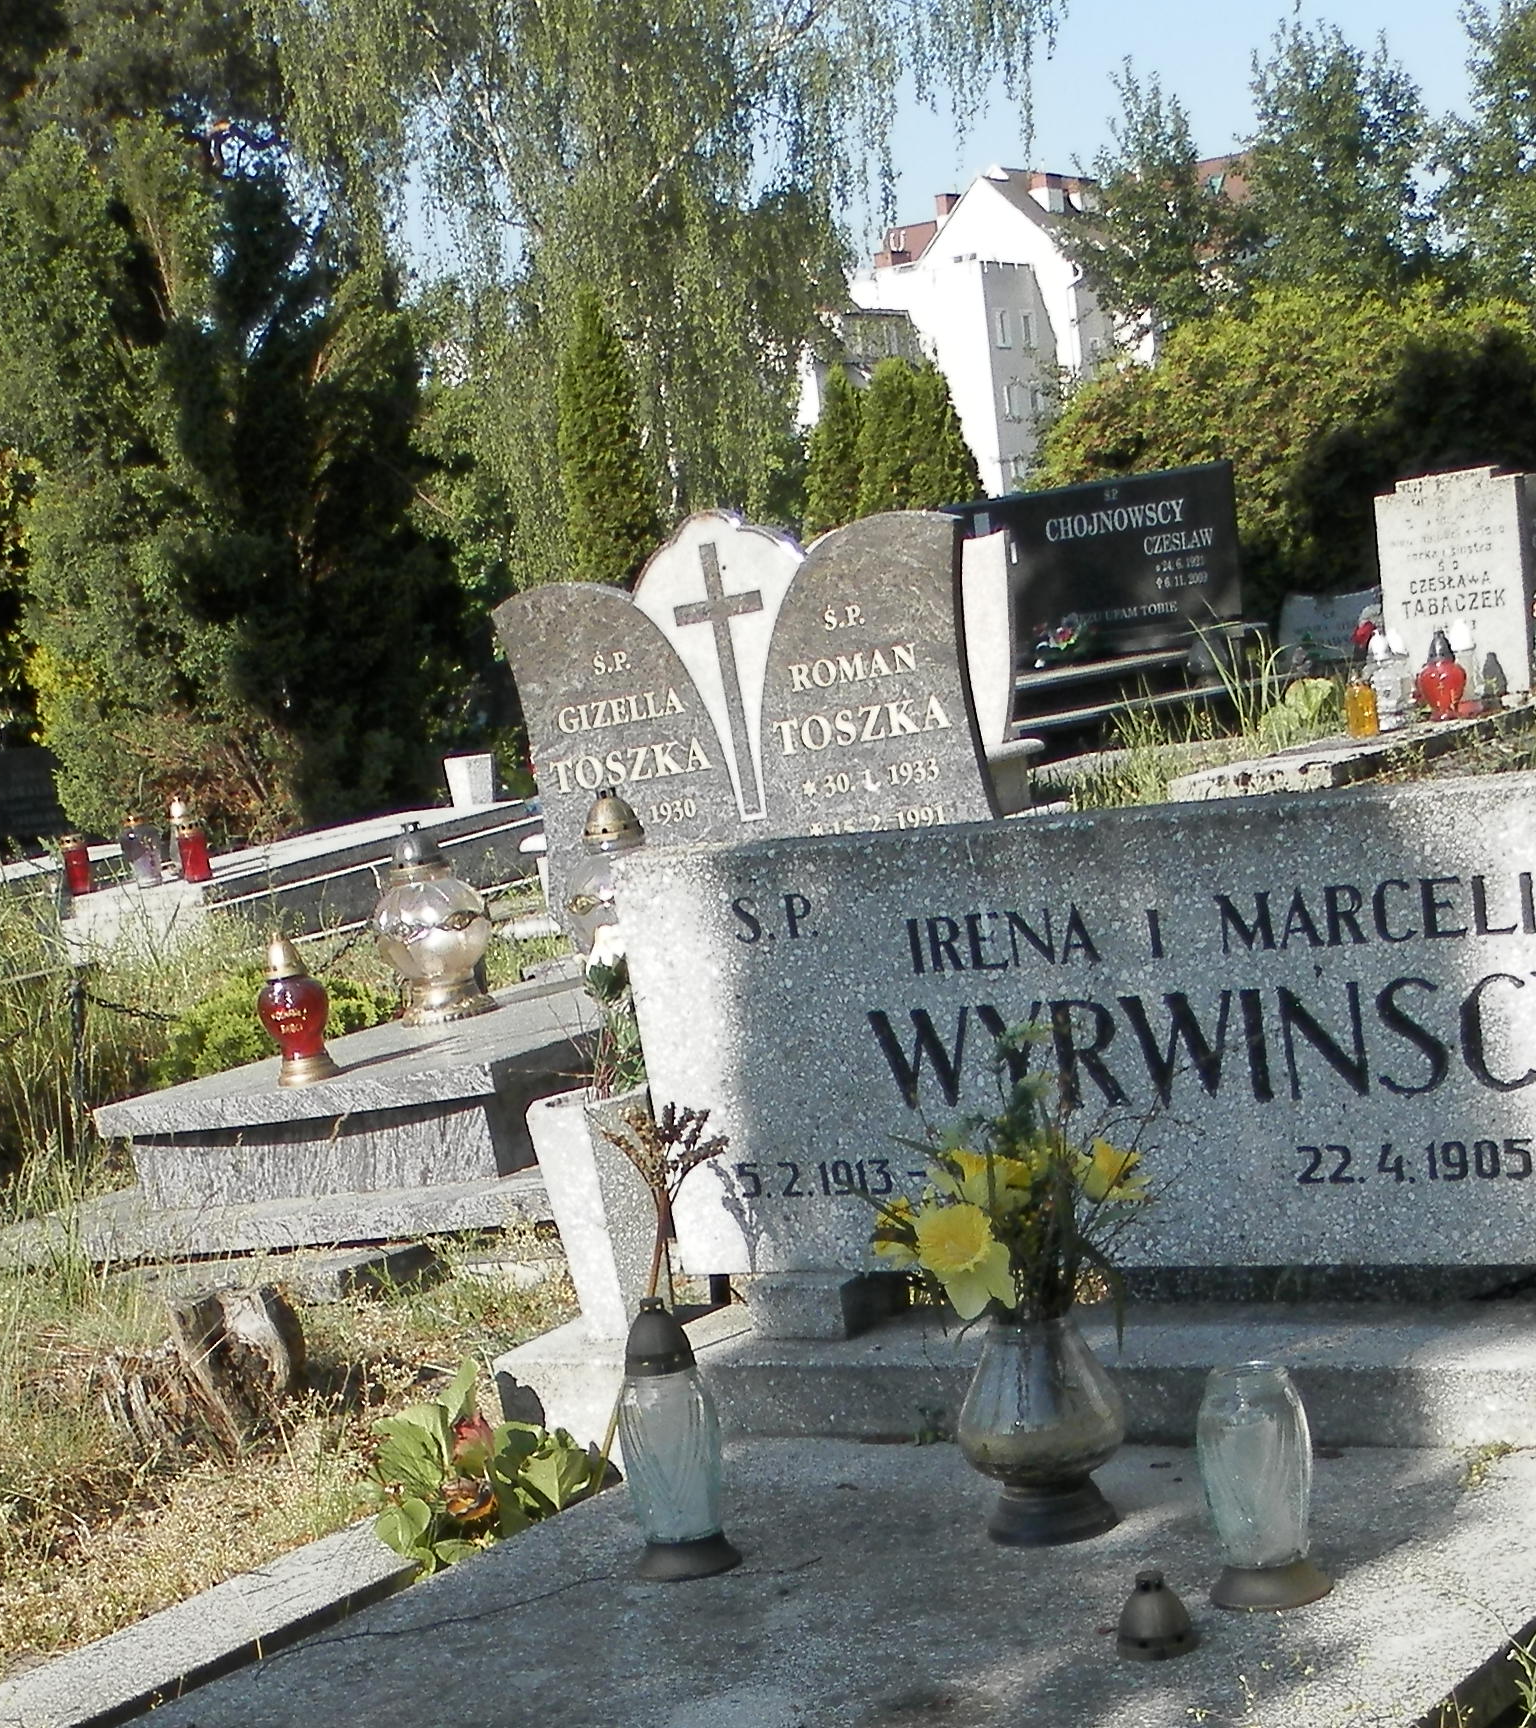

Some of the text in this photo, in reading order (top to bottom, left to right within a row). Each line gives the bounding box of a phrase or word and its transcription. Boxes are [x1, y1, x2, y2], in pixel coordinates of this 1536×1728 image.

[1045, 498, 1184, 542] CHOJNOWSCY
[824, 605, 866, 632] Ś.P.
[1402, 589, 1506, 619] TABACZEK
[593, 651, 632, 675] Ś.P.
[788, 643, 917, 693] ROMAN
[558, 688, 685, 734] GIZELLA
[773, 695, 952, 756] TOSZKA
[550, 737, 713, 794] TOSZKA
[887, 758, 940, 786] 1933
[650, 798, 697, 825] 1930
[896, 804, 947, 831] 1991
[906, 903, 1101, 975] IRENA
[1146, 908, 1164, 960] I
